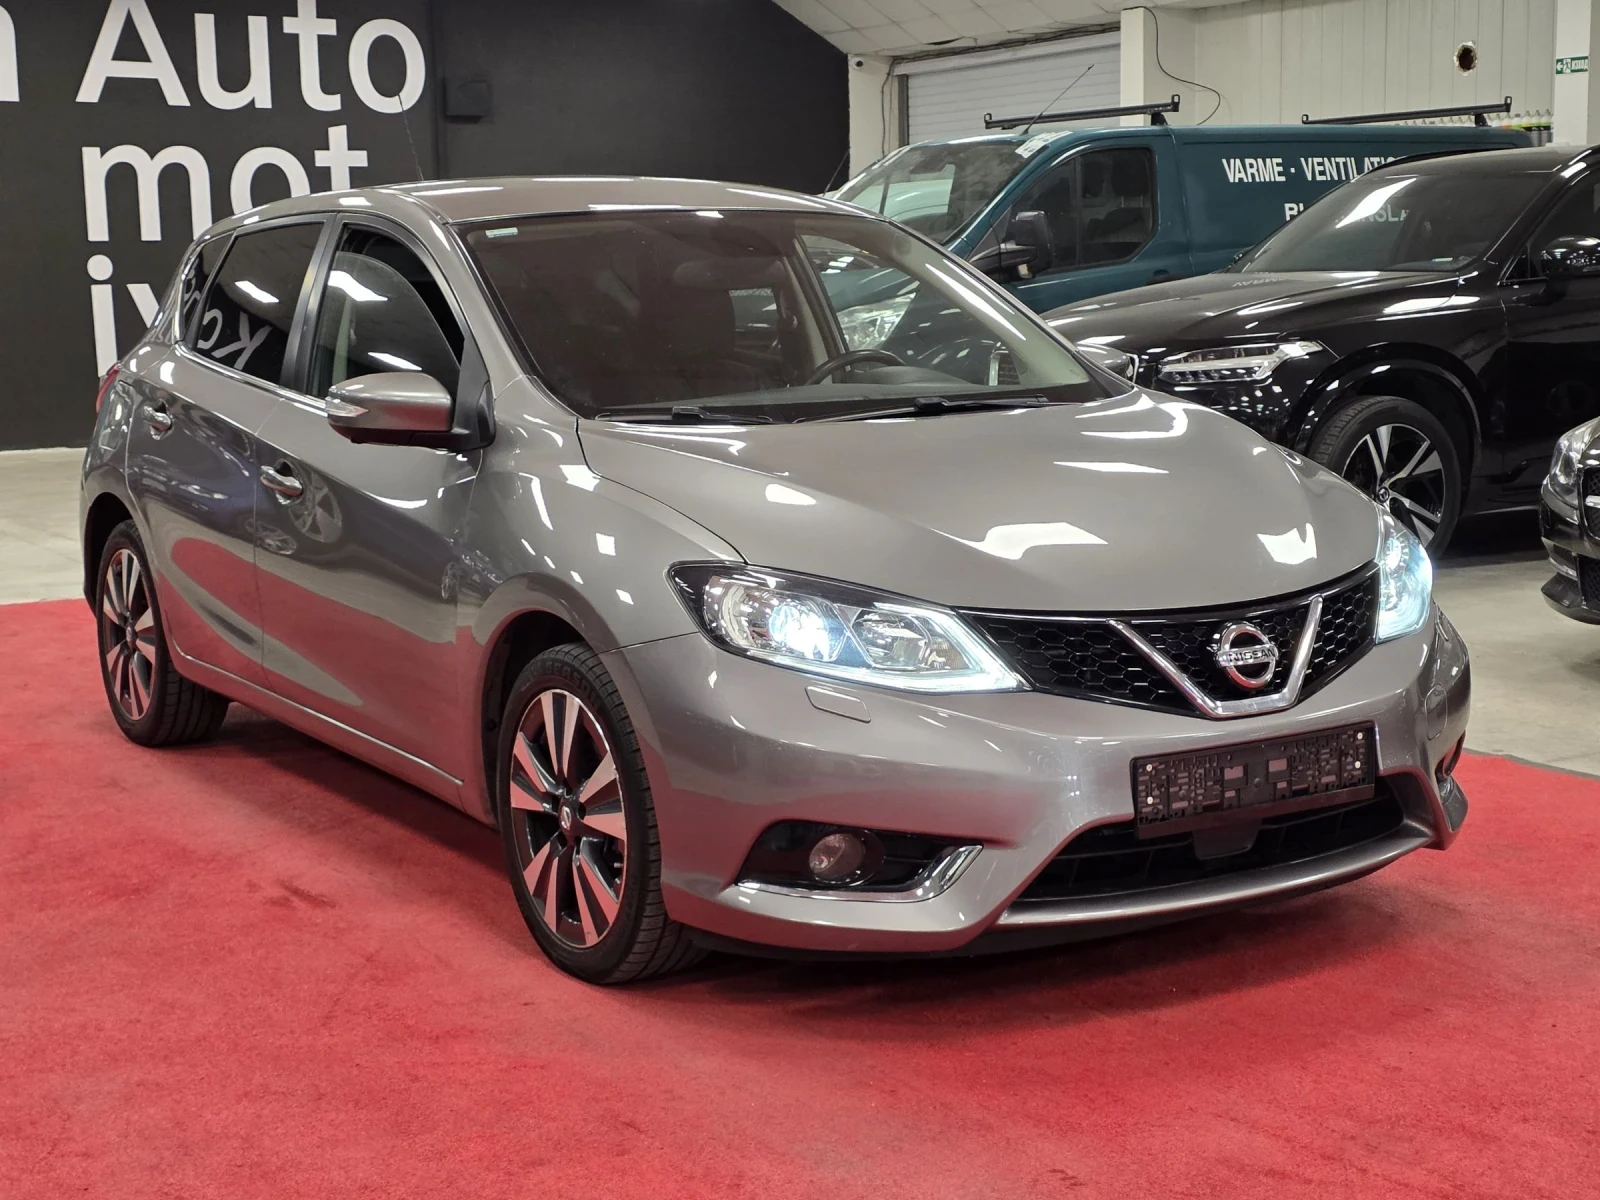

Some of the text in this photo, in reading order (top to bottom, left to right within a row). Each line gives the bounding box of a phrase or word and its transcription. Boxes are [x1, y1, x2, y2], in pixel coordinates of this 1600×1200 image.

[76, 0, 426, 114] Auto
[1222, 157, 1287, 183] VARME
[1229, 649, 1275, 662] NISSAN
